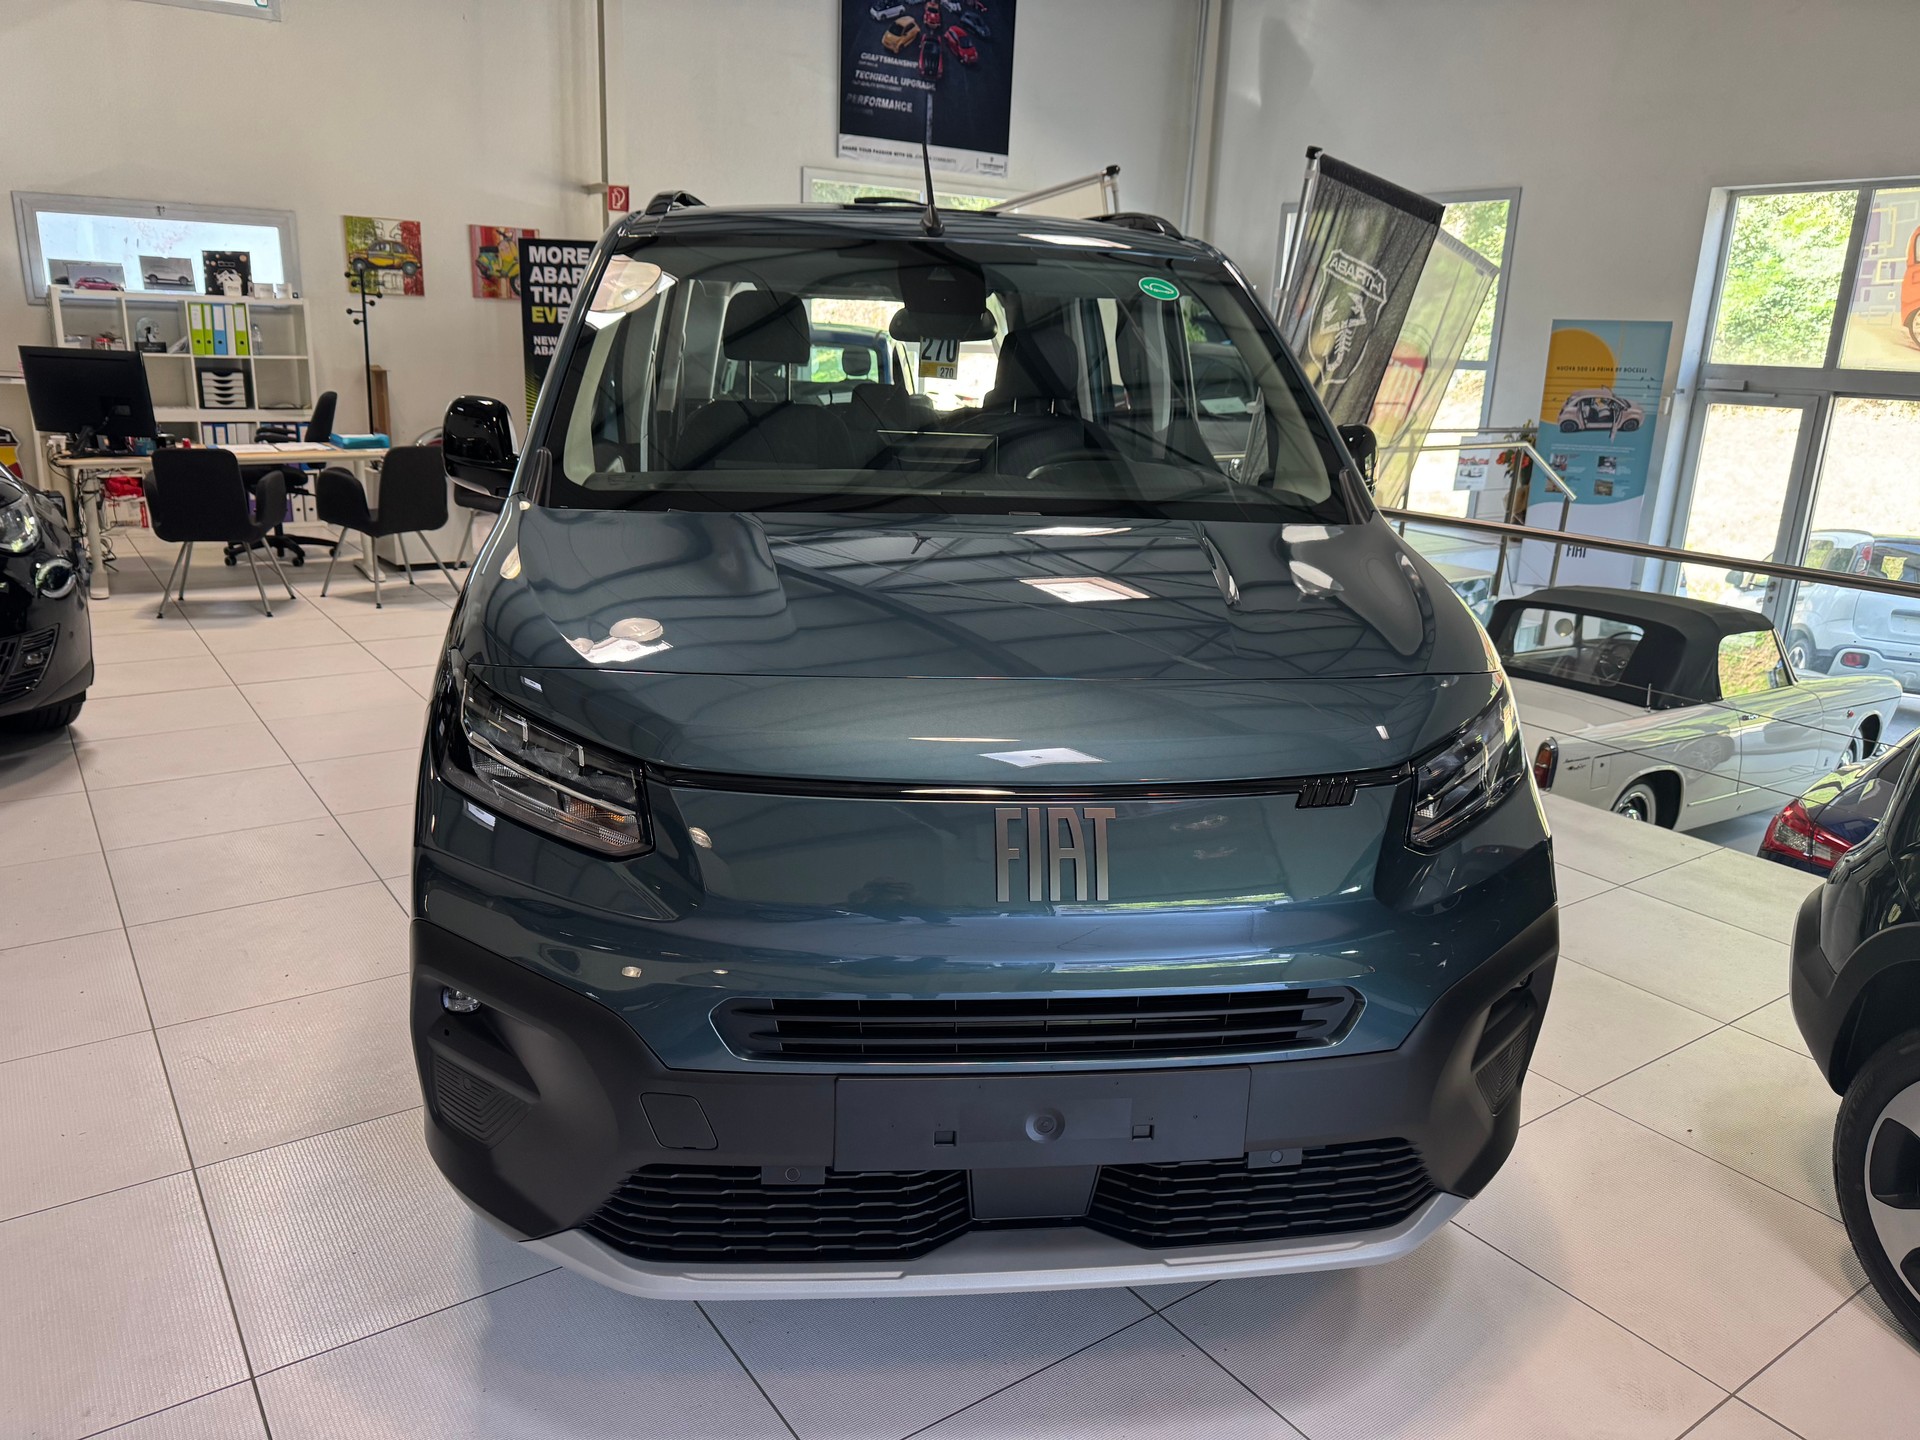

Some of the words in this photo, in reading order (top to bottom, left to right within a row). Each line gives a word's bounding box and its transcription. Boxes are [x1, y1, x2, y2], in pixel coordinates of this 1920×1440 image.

[860, 52, 919, 69] CRAFTSMANSHIP
[855, 69, 899, 85] TECHNICAL
[846, 93, 913, 113] PERFORMANCE
[528, 245, 590, 265] MORE
[1329, 257, 1382, 295] ABARTH
[921, 338, 958, 363] 270
[940, 367, 954, 378] 270
[995, 807, 1116, 902] FIAT
